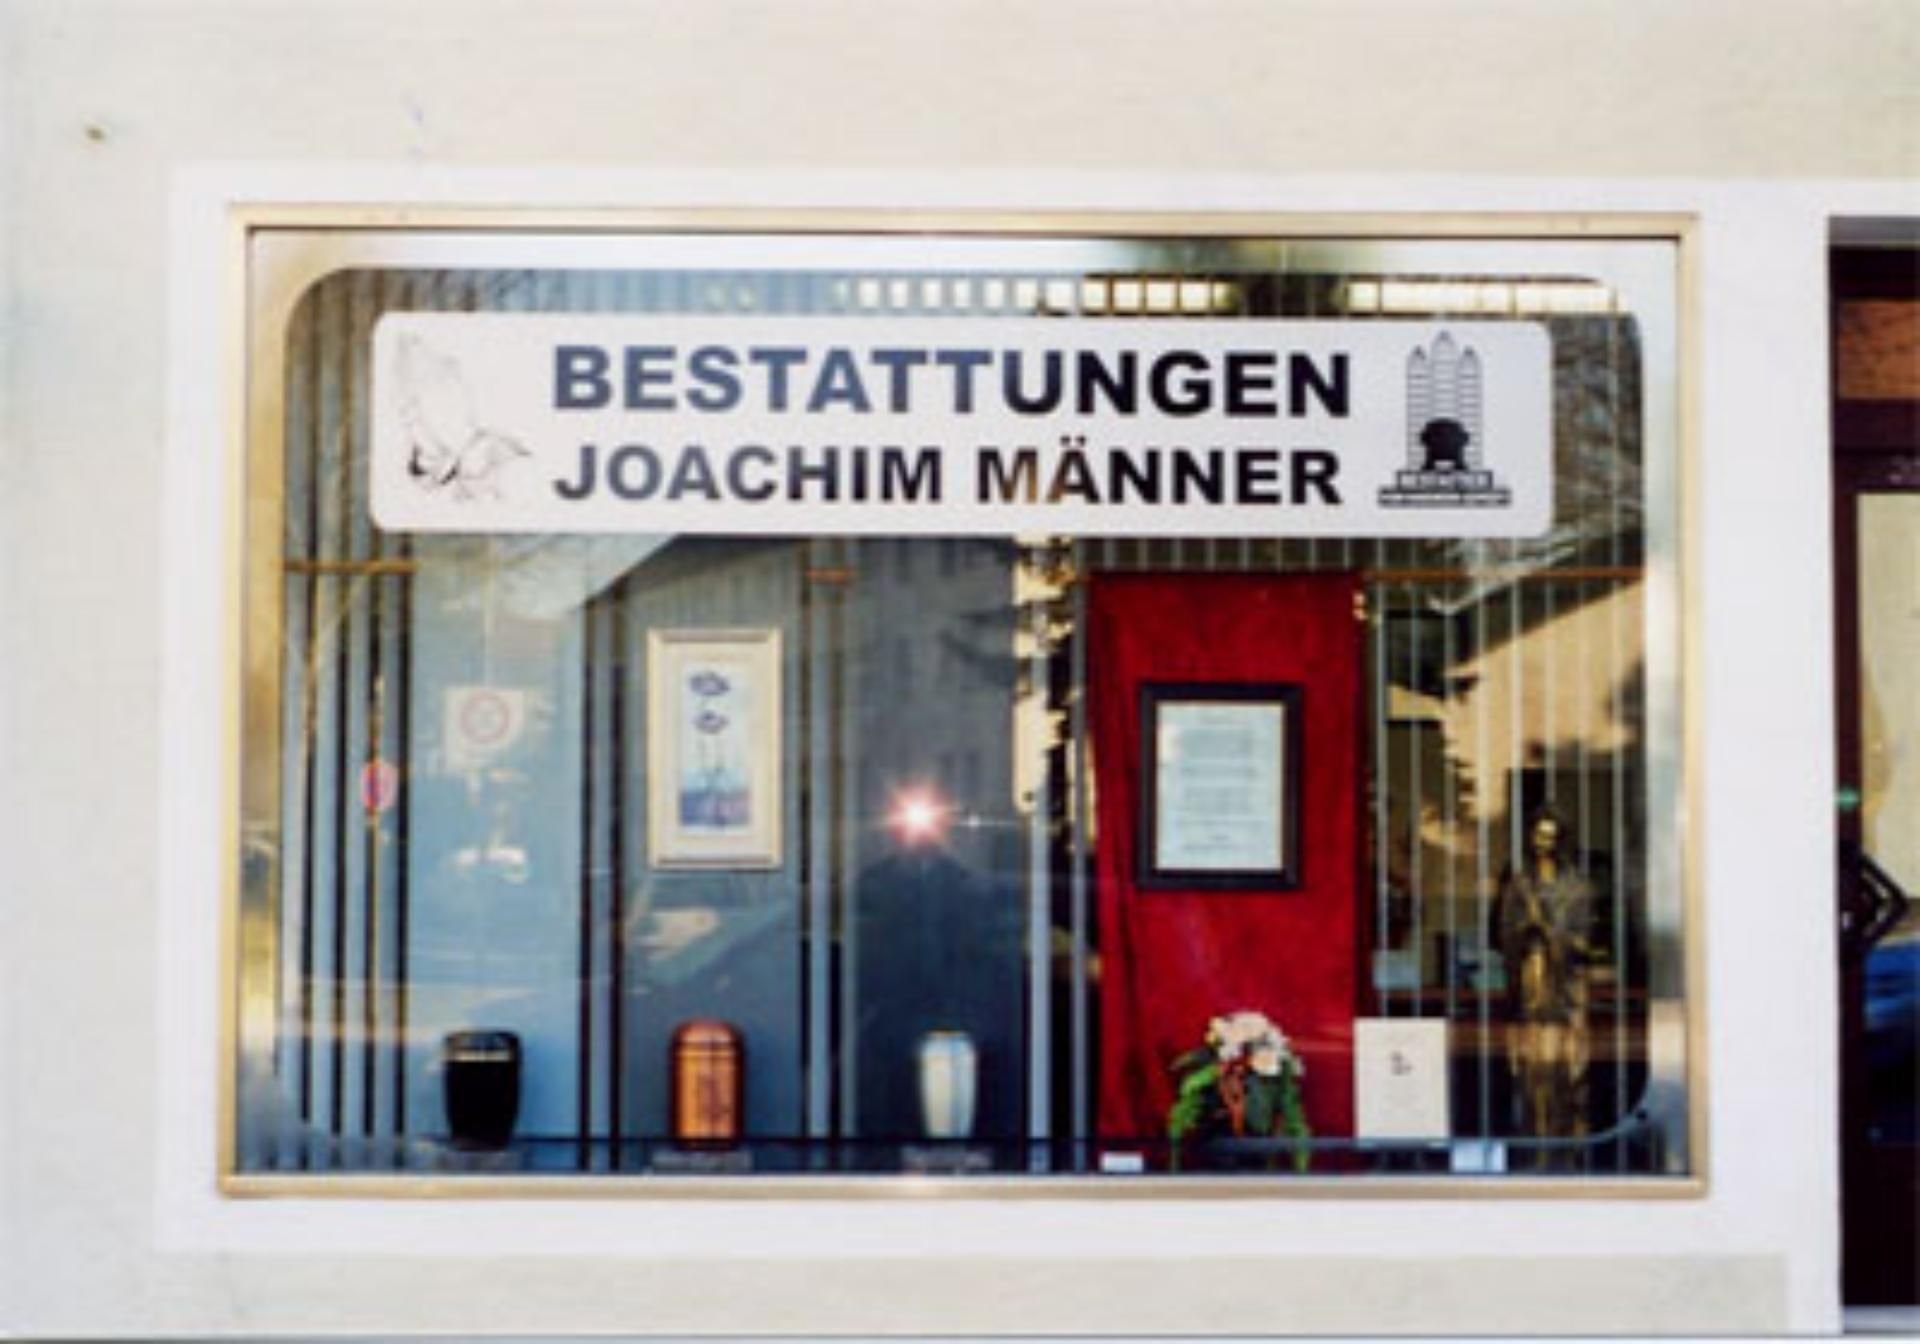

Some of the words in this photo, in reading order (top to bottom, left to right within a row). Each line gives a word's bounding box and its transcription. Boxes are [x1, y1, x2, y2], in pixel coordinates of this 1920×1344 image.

[553, 344, 1351, 418] BESTATTUNGEN
[553, 444, 943, 504] JOACHIM
[975, 435, 1345, 507] MÄNNER
